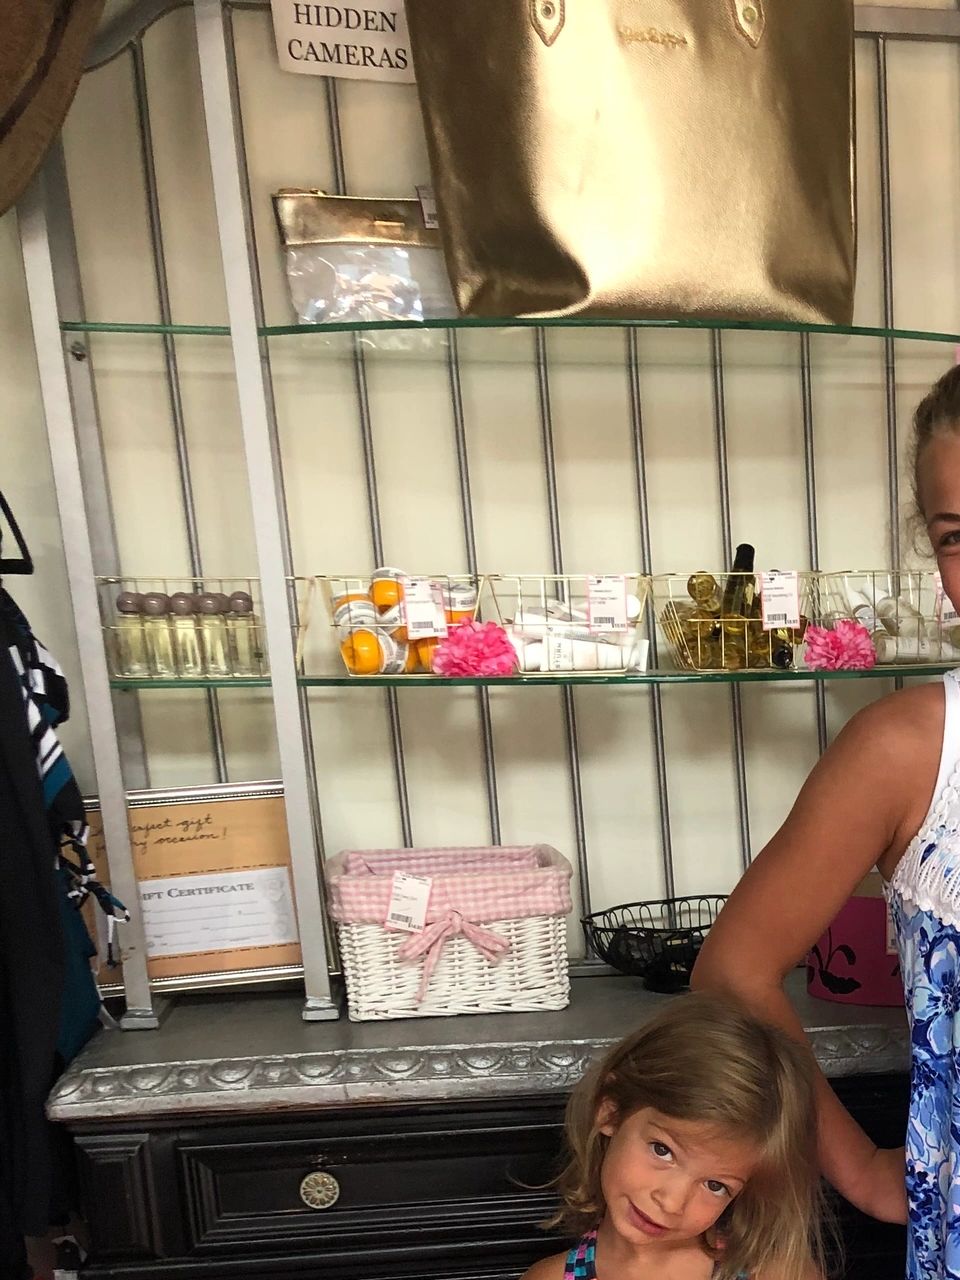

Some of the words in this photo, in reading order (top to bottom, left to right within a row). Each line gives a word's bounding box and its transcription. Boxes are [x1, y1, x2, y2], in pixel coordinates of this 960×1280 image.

[293, 3, 397, 32] HIDDEN
[287, 38, 408, 69] CAMERAS
[131, 818, 172, 839] erfect
[176, 813, 213, 832] gift
[142, 891, 163, 901] IFT
[167, 883, 255, 898] CERTIFICATE
